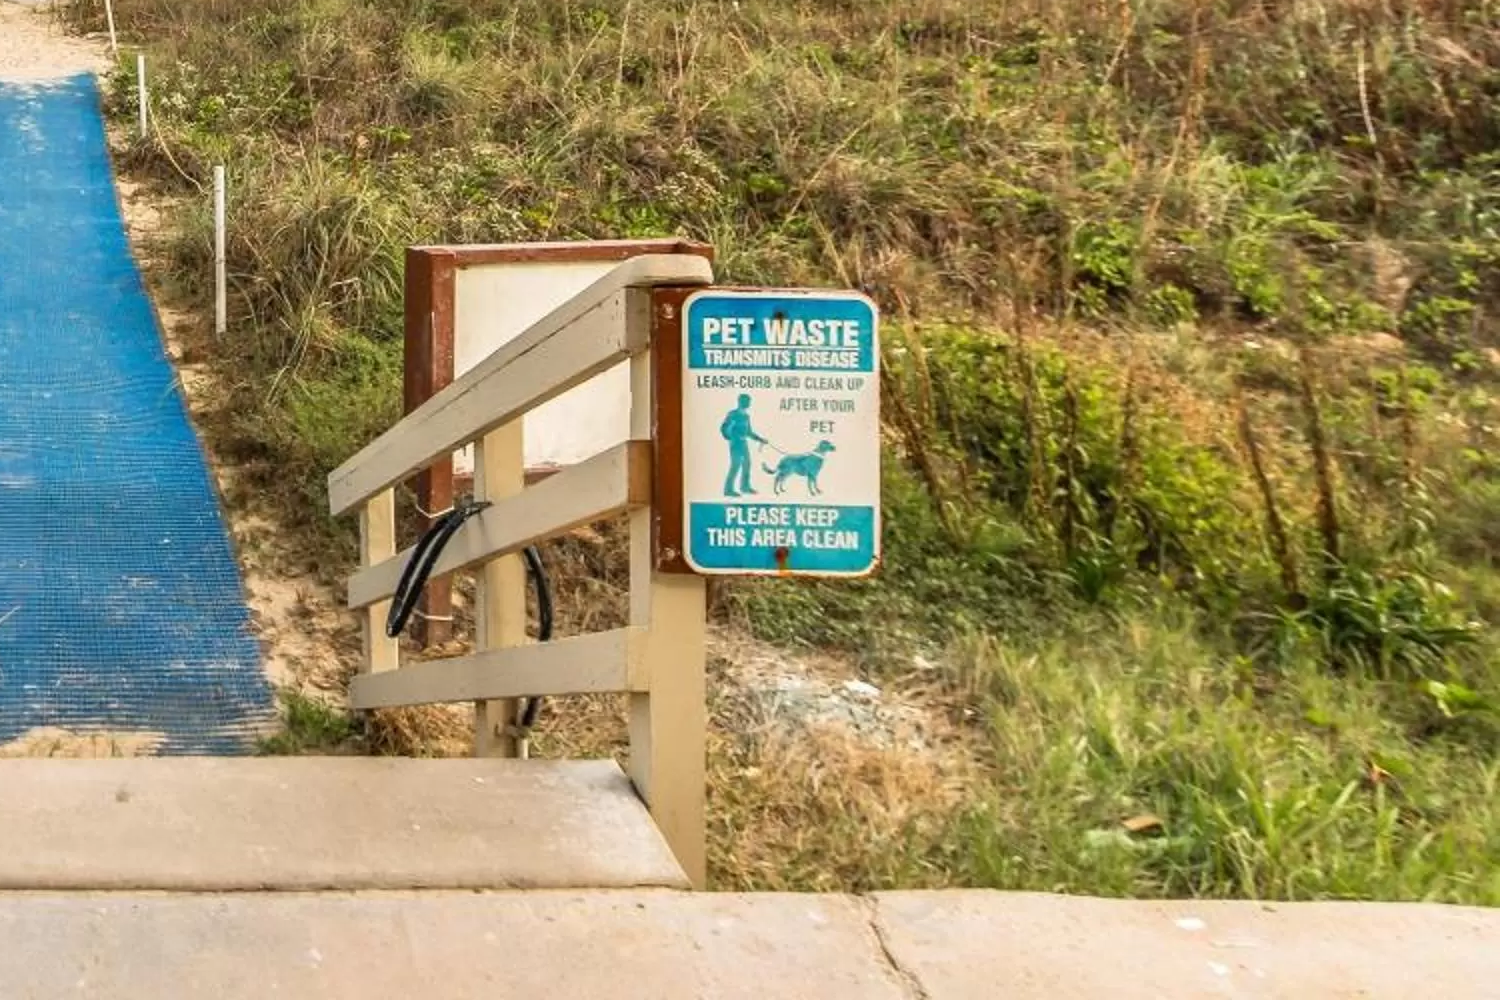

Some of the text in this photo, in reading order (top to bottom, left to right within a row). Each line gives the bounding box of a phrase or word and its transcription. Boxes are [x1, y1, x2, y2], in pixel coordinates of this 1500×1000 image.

[703, 318, 860, 346] PET WASTE
[705, 350, 859, 368] TRANSMITS DISEASE
[697, 375, 864, 391] LEASH-CURB AND CLEAN UP
[779, 400, 855, 413] AFTER YOUR
[809, 421, 834, 434] PET
[725, 507, 839, 527] PLEASE KEEP
[707, 528, 859, 549] THIS AREA CLEAN
